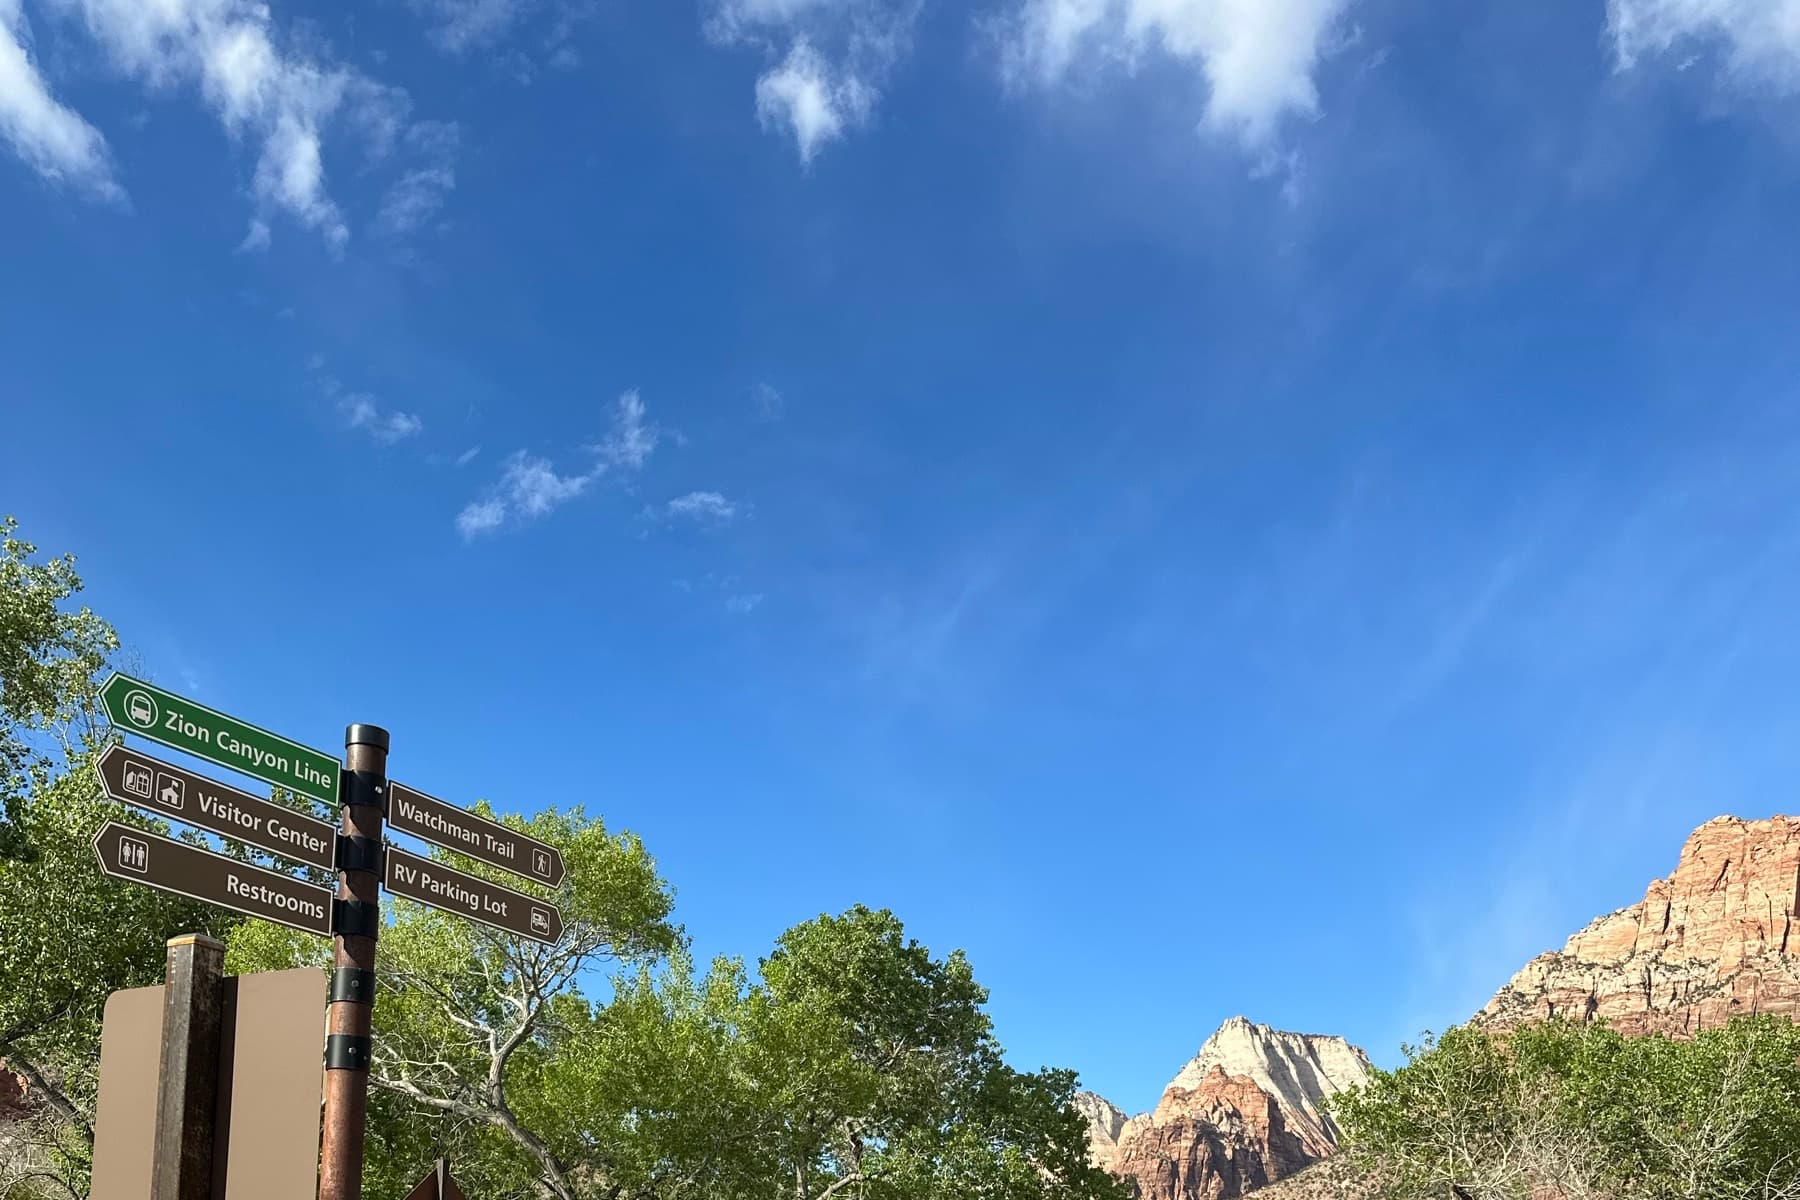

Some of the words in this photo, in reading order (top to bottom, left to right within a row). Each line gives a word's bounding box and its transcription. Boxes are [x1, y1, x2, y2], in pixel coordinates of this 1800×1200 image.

[165, 709, 210, 743] Zion
[216, 731, 289, 773] Canyon
[294, 759, 331, 789] Line
[198, 792, 262, 831] Visitor
[267, 820, 328, 854] Center
[398, 799, 480, 846] Watchman
[484, 833, 515, 859] Trail
[227, 874, 324, 919] Restrooms
[394, 863, 417, 884] RV
[421, 872, 479, 911] Parking
[484, 894, 508, 917] Lot
